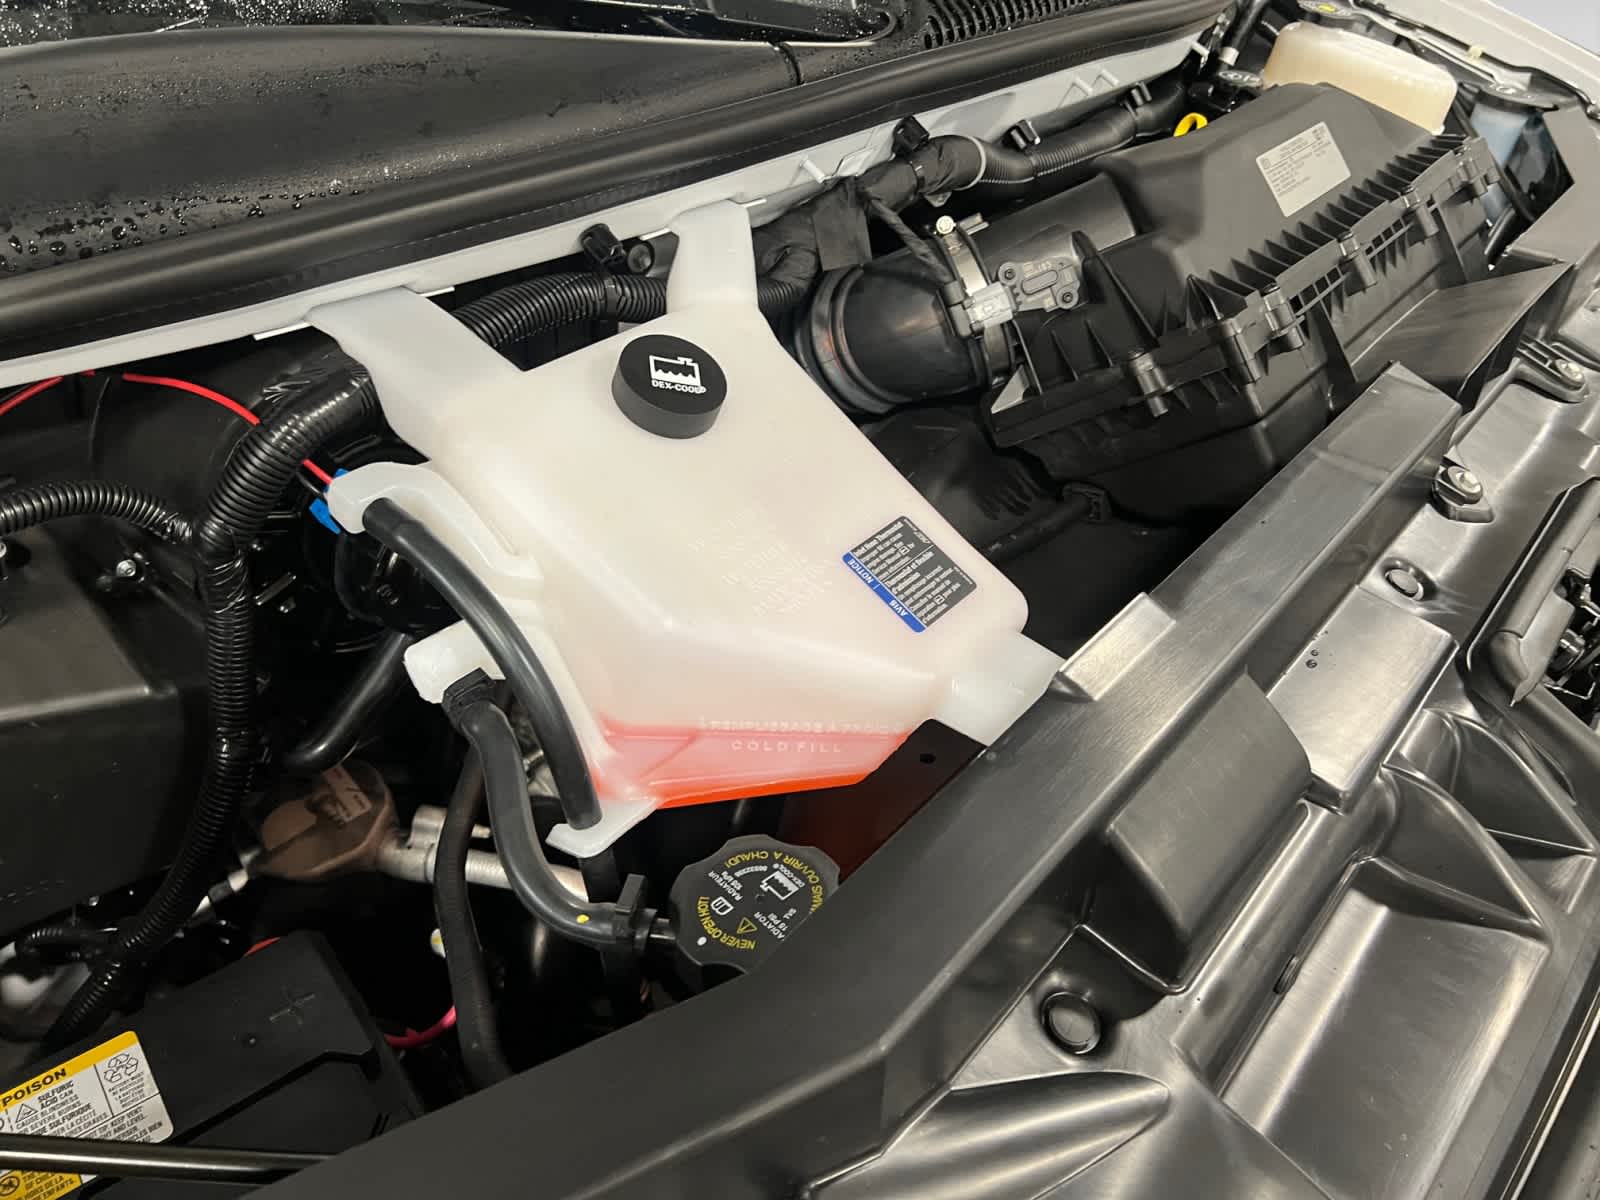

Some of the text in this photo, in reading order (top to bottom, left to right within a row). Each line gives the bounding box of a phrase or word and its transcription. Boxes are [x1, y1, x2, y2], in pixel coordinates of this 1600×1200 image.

[847, 558, 874, 584] NOTICE
[888, 599, 909, 617] AVIS
[731, 740, 841, 753] COLD FILL
[783, 855, 820, 884] OUVRIR
[708, 870, 743, 900] RADIATEUR
[697, 896, 757, 950] NEVER OPEN HOT!
[754, 911, 786, 941] ADIATOR
[768, 913, 781, 925] PSI
[2, 1068, 66, 1106] POISON
[36, 1080, 74, 1103] SULFURIC
[39, 1088, 73, 1109] ACID CAN
[14, 1113, 40, 1130] CAUSE
[39, 1093, 79, 1117] BLINDNESS
[29, 1112, 57, 1130] SEVERE
[47, 1102, 92, 1129] SULFURIQUE
[110, 1115, 126, 1127] KEEP
[112, 1123, 126, 1133] AND
